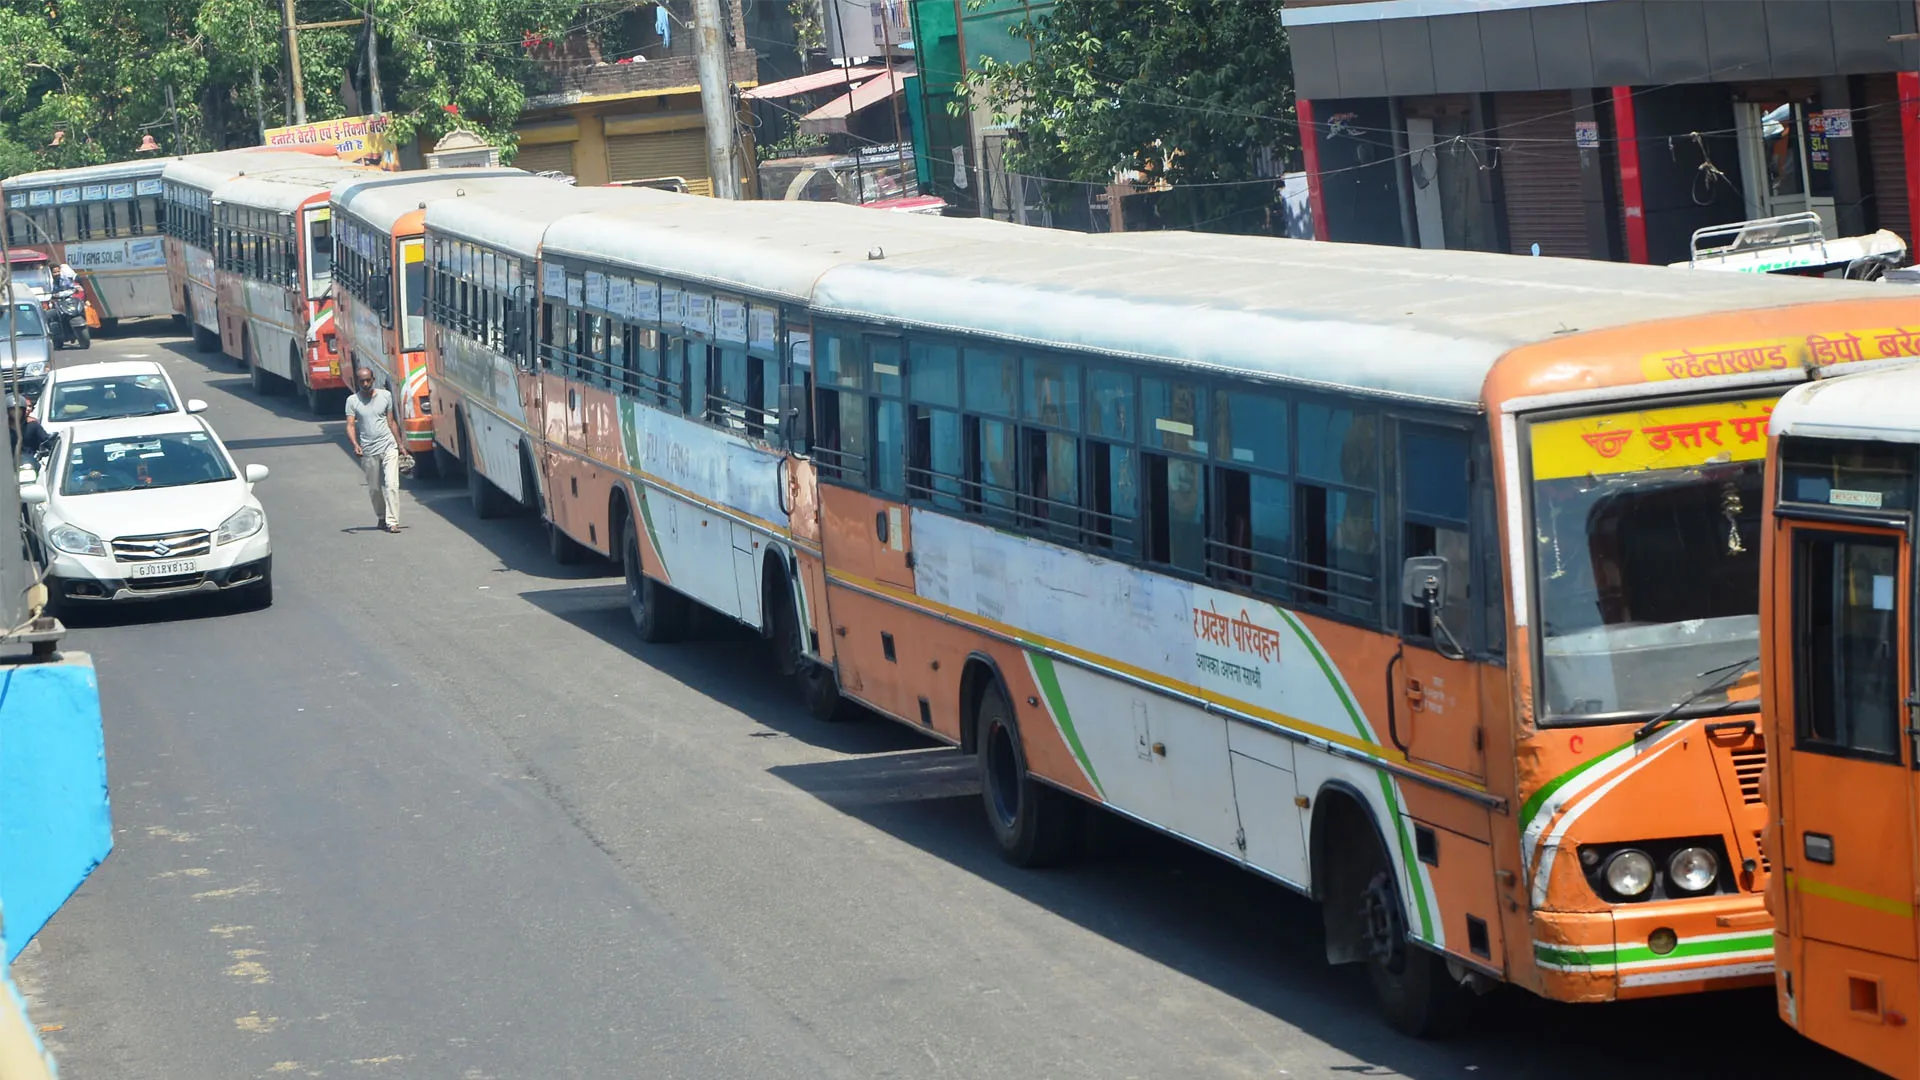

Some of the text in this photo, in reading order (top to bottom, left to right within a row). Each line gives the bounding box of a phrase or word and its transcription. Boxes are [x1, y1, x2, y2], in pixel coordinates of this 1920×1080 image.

[1806, 332, 1865, 367] डिपो
[1641, 420, 1723, 451] उत्तर
[1201, 598, 1230, 648] प्रदेश
[1231, 609, 1280, 663] परिवहन
[1196, 652, 1220, 677] आपका
[1220, 660, 1241, 683] अपना
